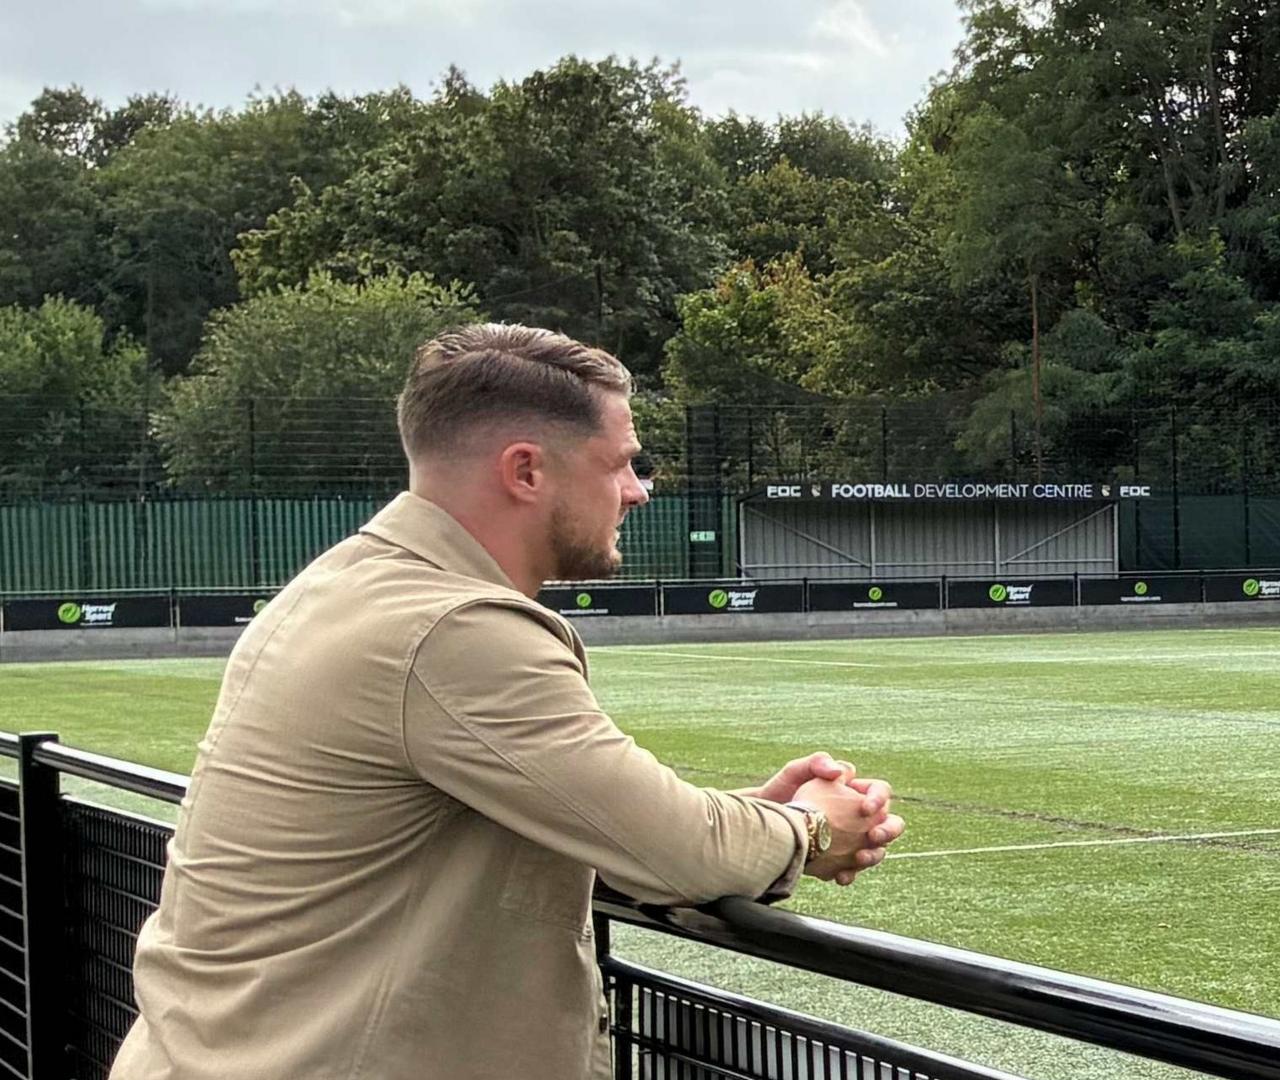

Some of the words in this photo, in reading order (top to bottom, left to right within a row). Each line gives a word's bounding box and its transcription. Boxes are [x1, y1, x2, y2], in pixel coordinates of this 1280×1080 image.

[832, 483, 910, 498] FOOTBALL
[914, 483, 1029, 498] DEVELOPMENT
[1033, 483, 1093, 498] CENTRE
